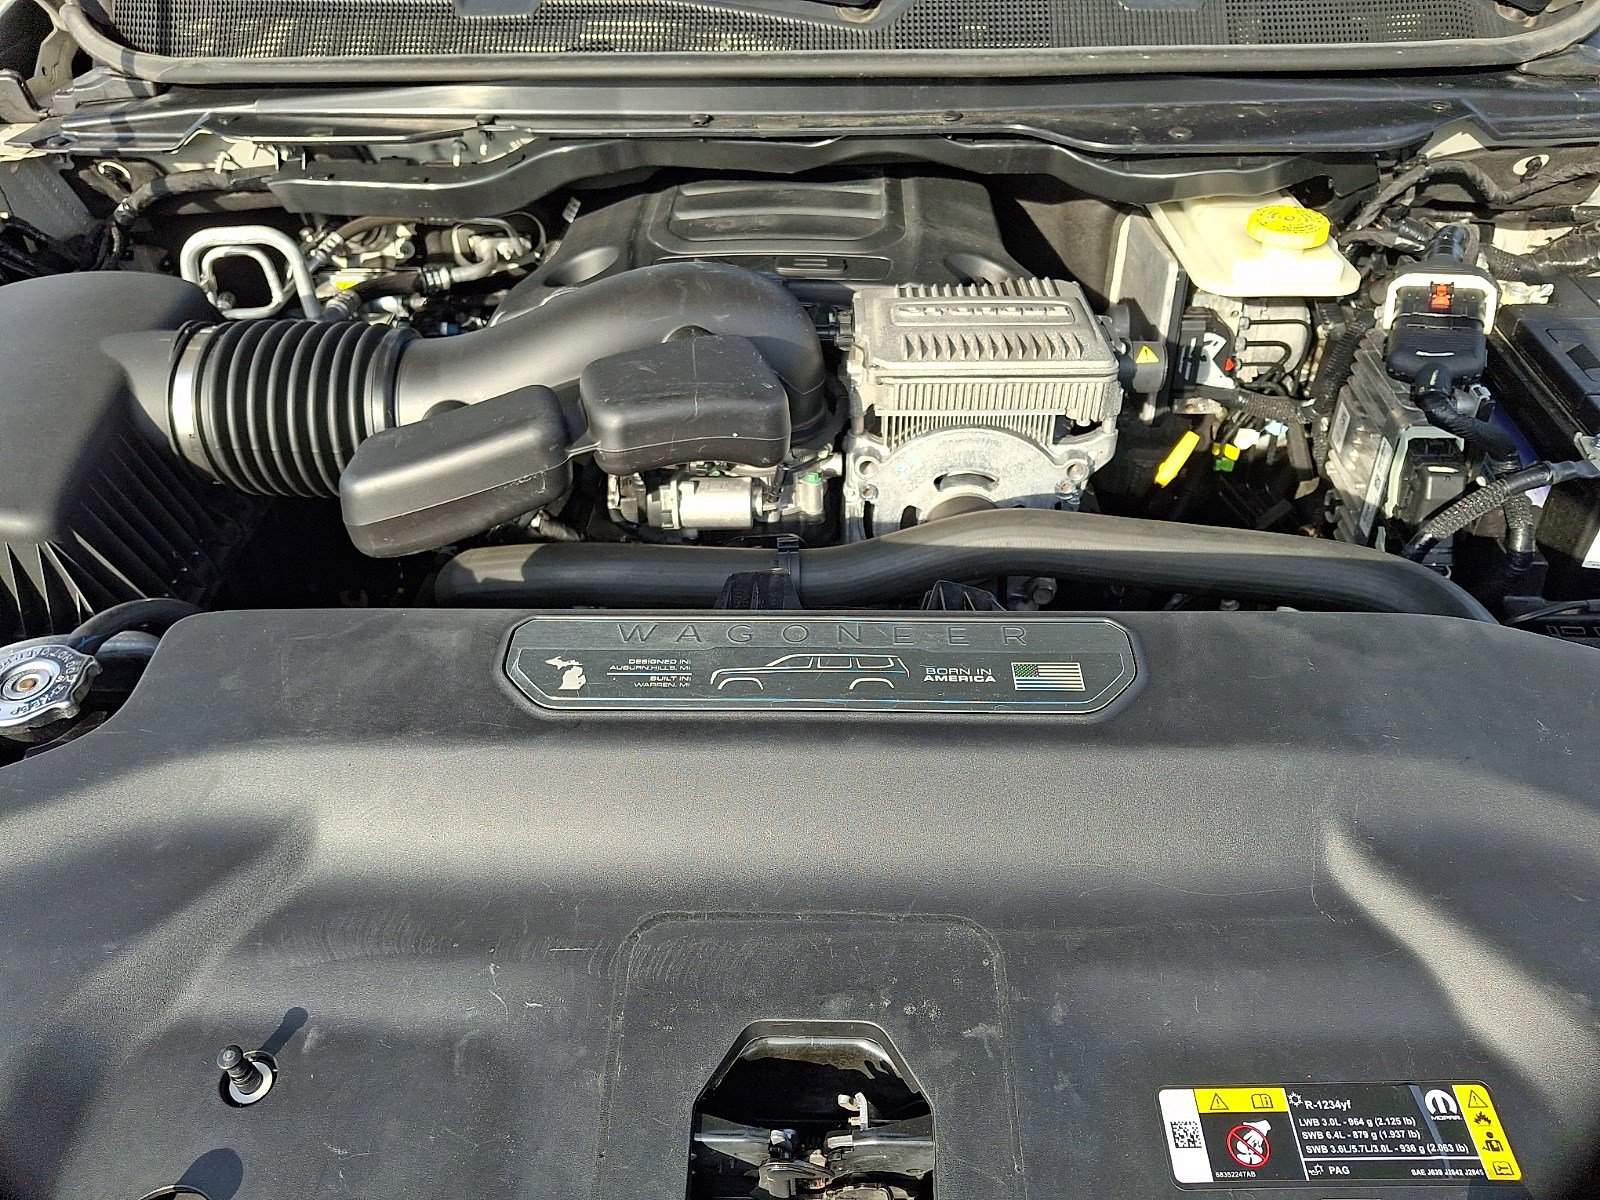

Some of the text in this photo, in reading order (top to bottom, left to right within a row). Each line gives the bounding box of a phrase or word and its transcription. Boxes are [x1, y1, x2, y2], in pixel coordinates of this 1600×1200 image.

[617, 624, 1027, 646] WAGONEER
[926, 667, 970, 675] BORN
[923, 674, 997, 683] AMERICA
[1304, 1099, 1352, 1112] R-1234yf
[1298, 1118, 1321, 1127] LWB
[1321, 1118, 1342, 1127] 3.0L
[1347, 1117, 1365, 1126] 964
[1366, 1119, 1374, 1128] g
[1374, 1117, 1402, 1127] (2.125
[1403, 1117, 1416, 1127] lb)
[1301, 1131, 1325, 1140] SWB
[1325, 1131, 1346, 1139] 6.4L
[1352, 1130, 1369, 1139] 879
[1371, 1132, 1378, 1141] g
[1379, 1130, 1406, 1140] (1.937
[1407, 1129, 1421, 1140] lb)
[1305, 1144, 1329, 1154] SWB
[1399, 1144, 1417, 1153] 936
[1418, 1146, 1426, 1154] g
[1426, 1143, 1455, 1154] (2.063
[1456, 1143, 1469, 1154] lb)
[1328, 1165, 1351, 1175] PAG
